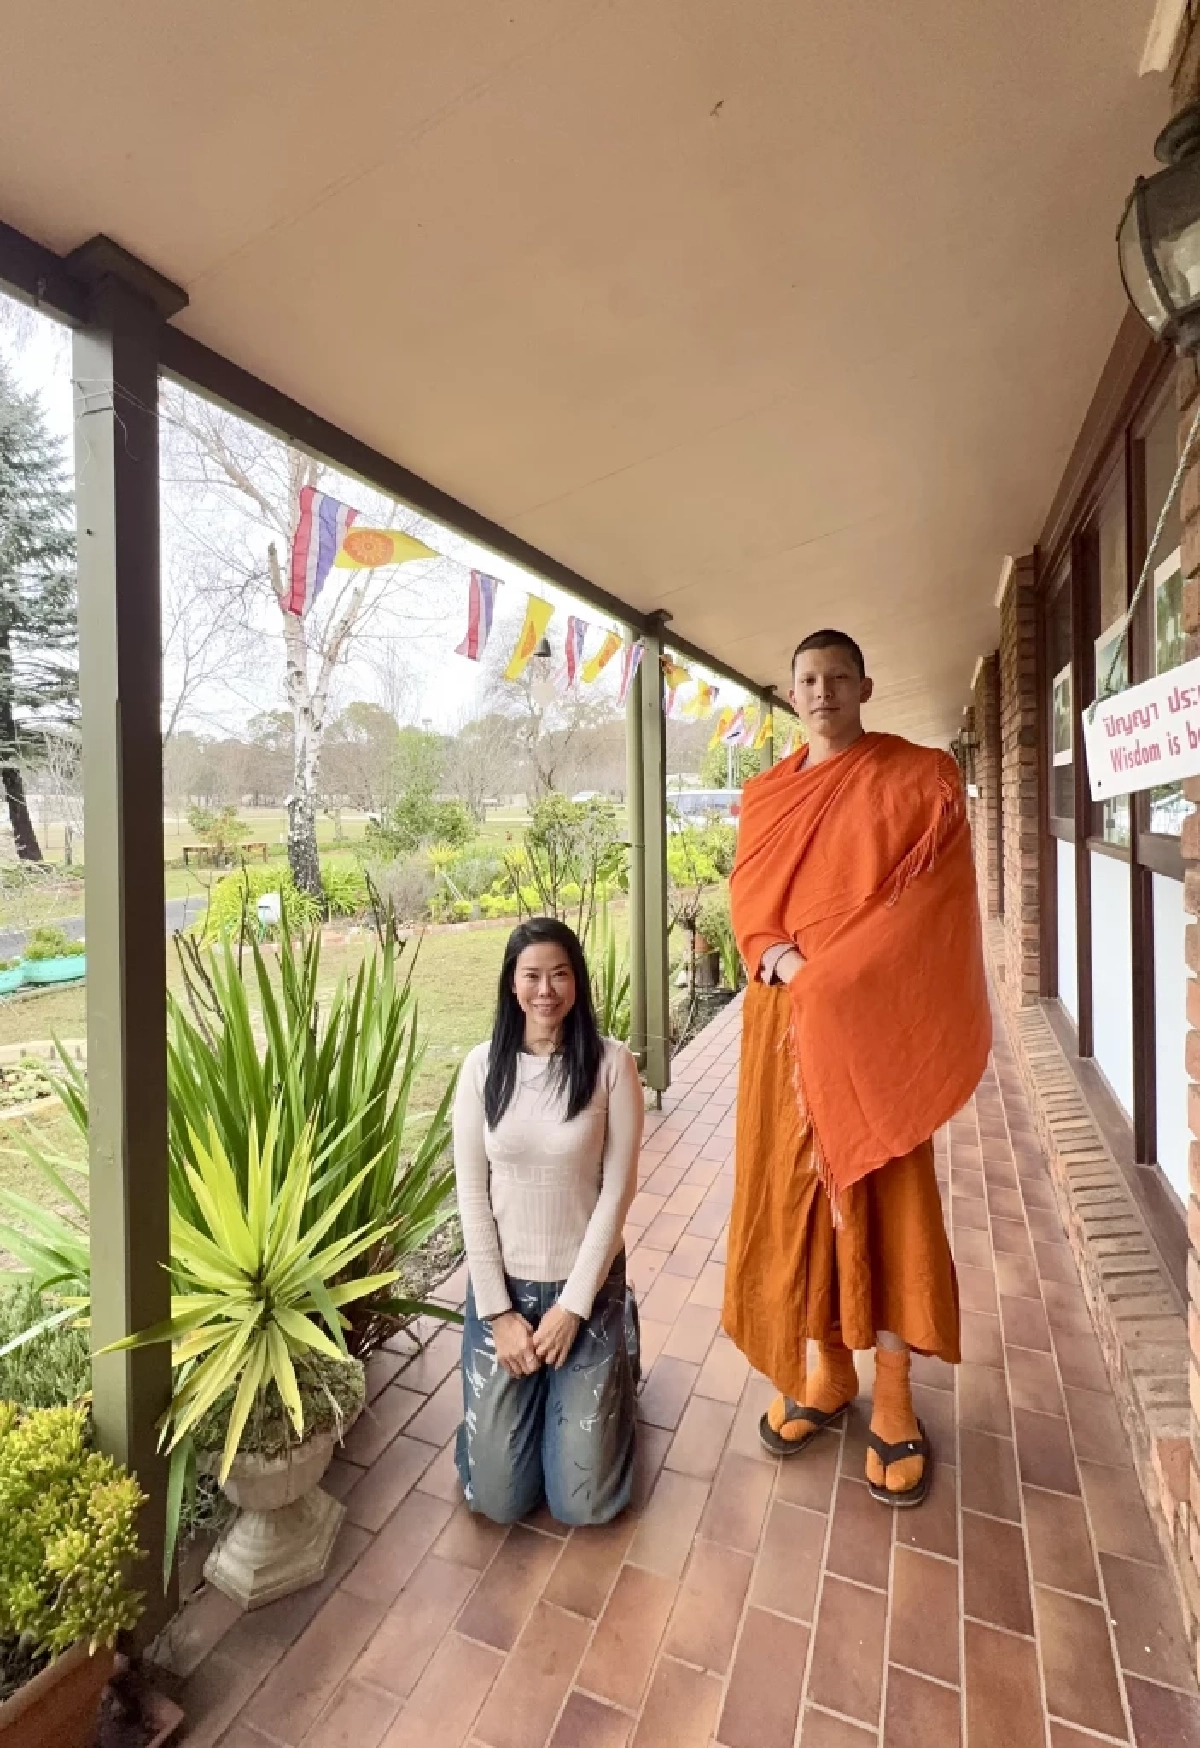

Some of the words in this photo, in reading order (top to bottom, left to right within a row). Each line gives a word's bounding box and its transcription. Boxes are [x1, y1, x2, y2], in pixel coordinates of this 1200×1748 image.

[1168, 685, 1200, 714] ประ
[1110, 739, 1161, 772] Wisdom
[1166, 732, 1180, 756] is
[1186, 720, 1200, 749] b
